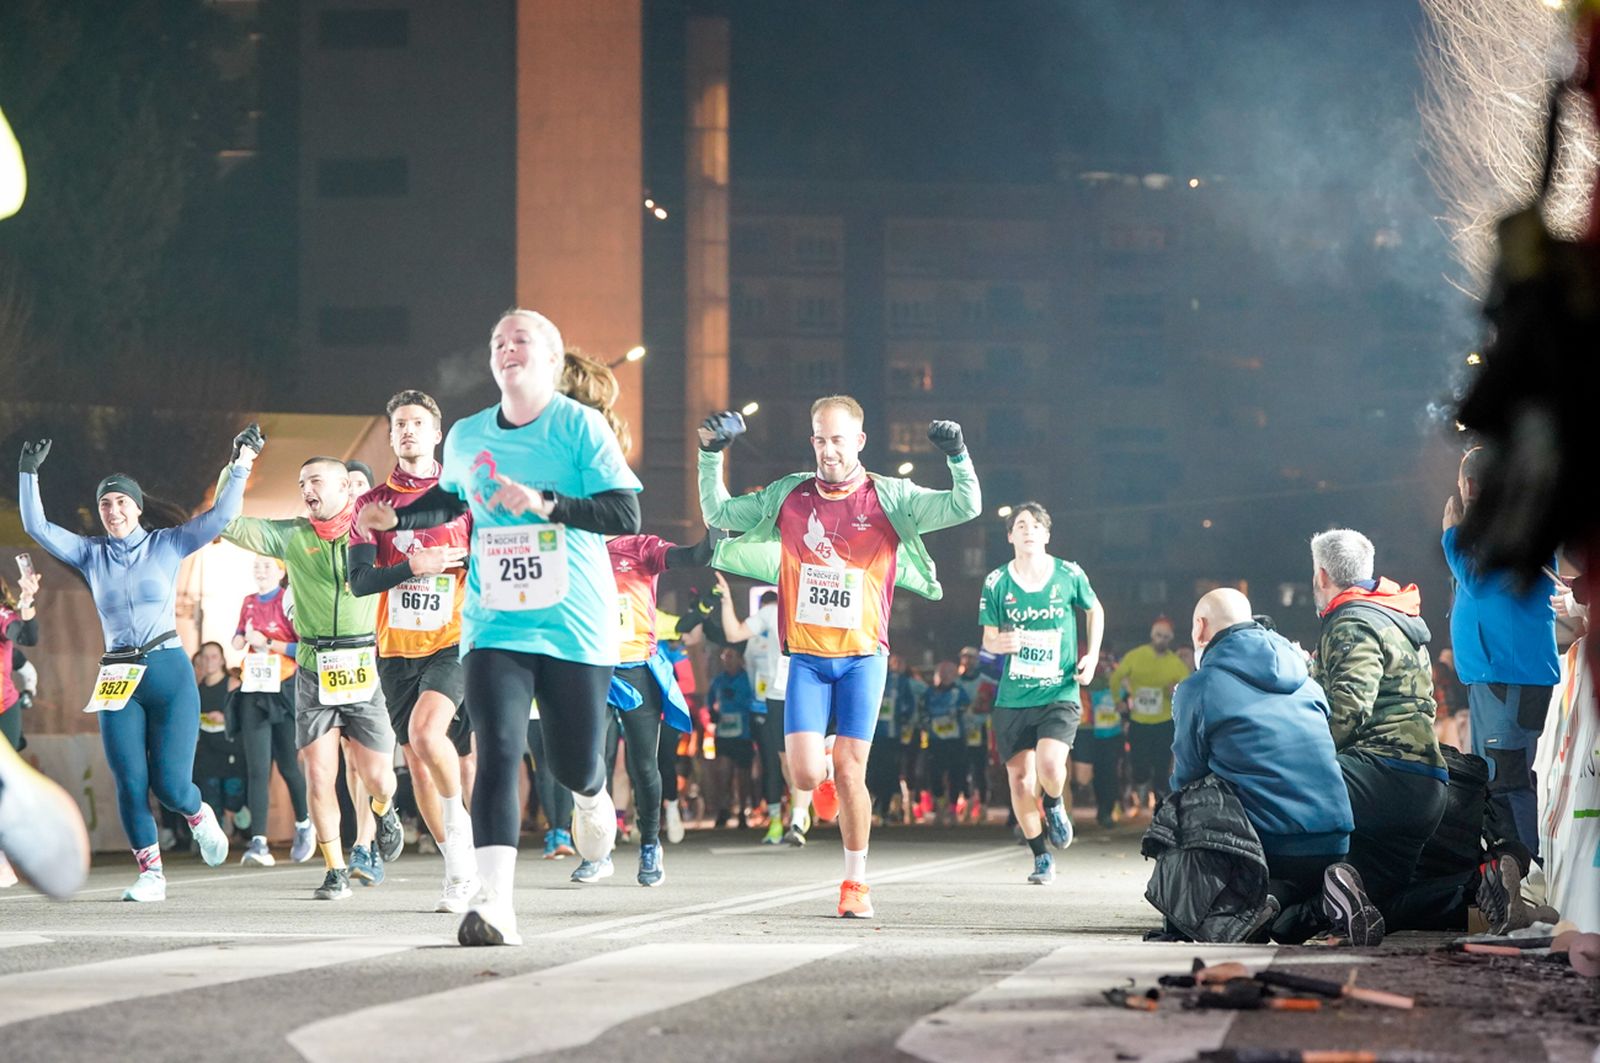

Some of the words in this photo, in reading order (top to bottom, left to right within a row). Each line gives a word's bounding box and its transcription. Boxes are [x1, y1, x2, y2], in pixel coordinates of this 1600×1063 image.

[494, 536, 517, 545] NOCHE
[520, 535, 529, 544] DE
[487, 547, 500, 556] SAN
[815, 542, 832, 559] 43
[499, 556, 543, 582] 255
[401, 591, 441, 612] 6673
[809, 586, 851, 609] 3346
[1006, 604, 1064, 622] Kubota
[99, 681, 129, 695] 3527
